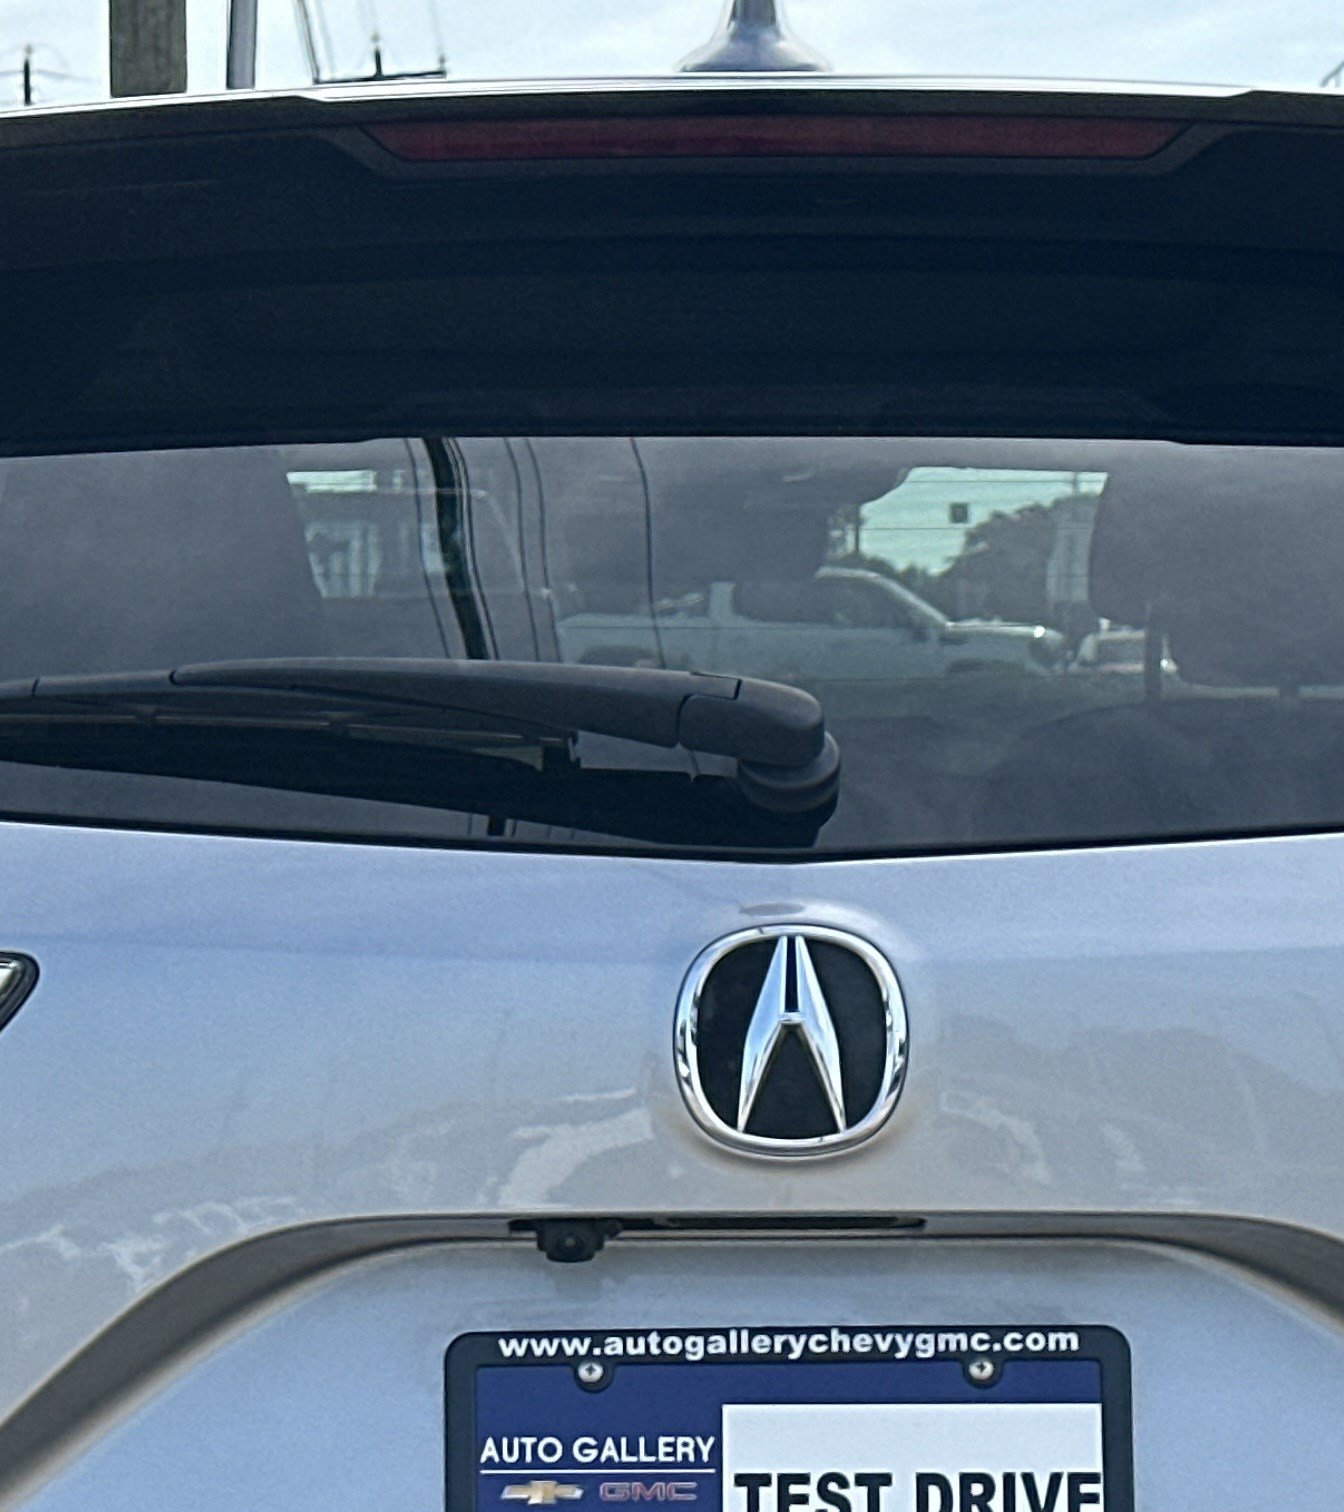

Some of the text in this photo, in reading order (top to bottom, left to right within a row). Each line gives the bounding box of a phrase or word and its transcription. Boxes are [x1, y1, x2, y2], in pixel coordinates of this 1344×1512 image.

[497, 1327, 1080, 1362] www.autogallerychevygmc.com
[479, 1435, 716, 1464] AUTO GALLERY
[599, 1481, 698, 1502] GMC
